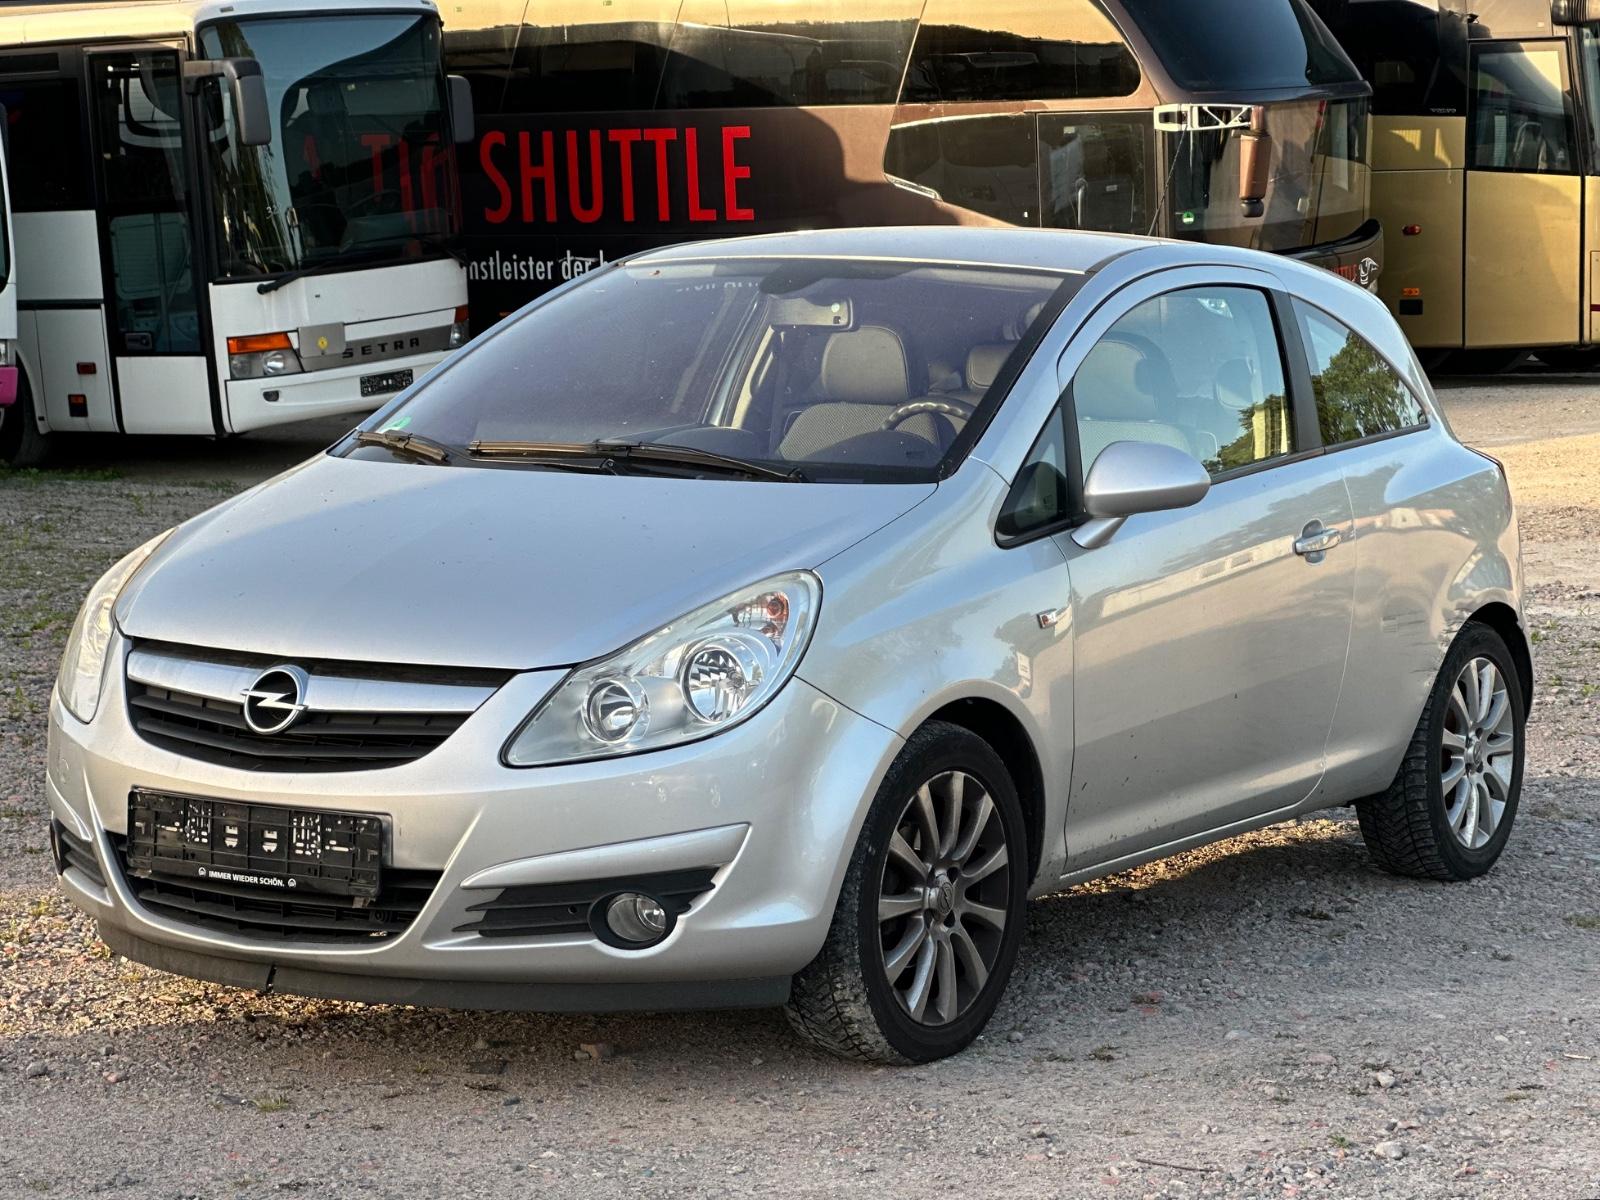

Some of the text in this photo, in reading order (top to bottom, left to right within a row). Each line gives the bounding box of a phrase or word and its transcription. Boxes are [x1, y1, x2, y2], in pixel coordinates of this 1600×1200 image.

[479, 125, 755, 223] SHUTTLE
[342, 337, 420, 359] SETRA
[208, 870, 285, 887] IMMER WIEDER SCHÖN.
